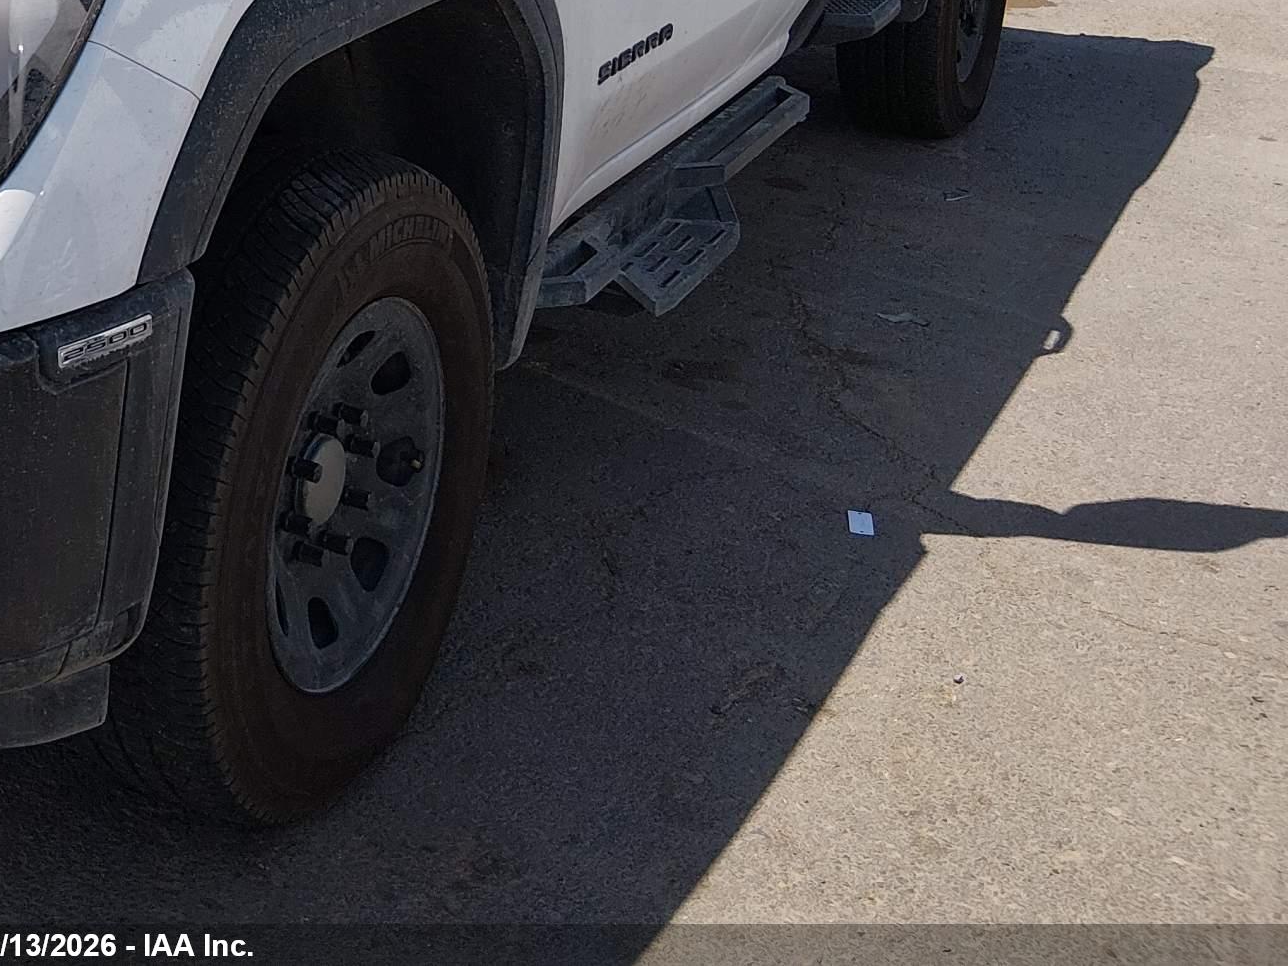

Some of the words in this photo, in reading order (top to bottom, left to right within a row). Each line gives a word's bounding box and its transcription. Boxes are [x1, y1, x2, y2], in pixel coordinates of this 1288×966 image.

[597, 23, 673, 85] SIERRA
[369, 215, 454, 261] MICHELIN
[62, 321, 148, 362] 2500
